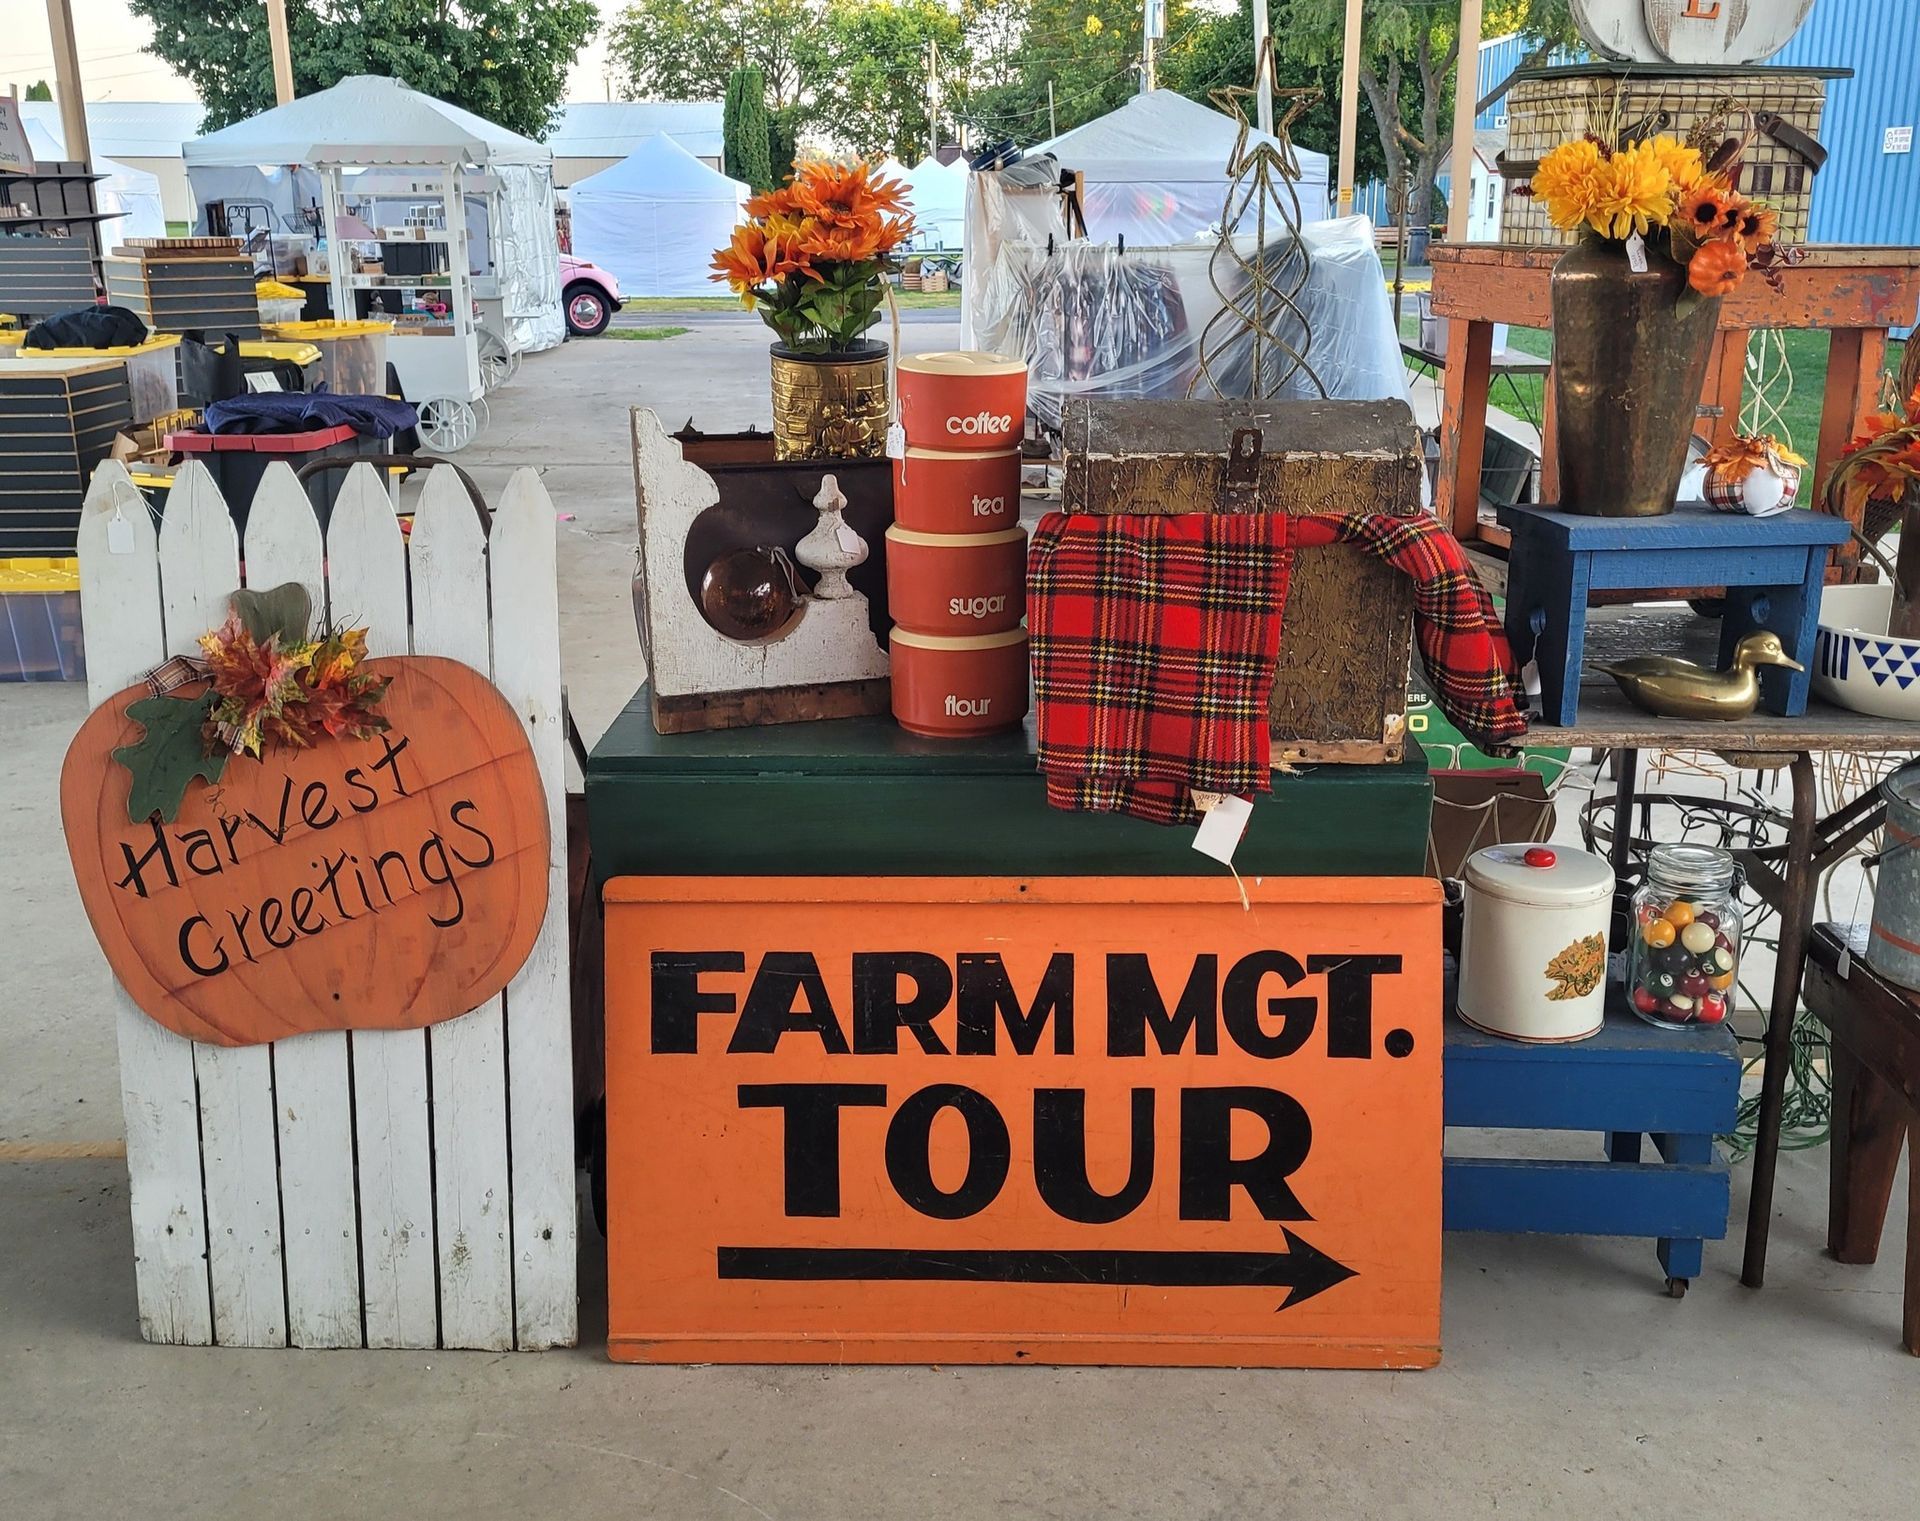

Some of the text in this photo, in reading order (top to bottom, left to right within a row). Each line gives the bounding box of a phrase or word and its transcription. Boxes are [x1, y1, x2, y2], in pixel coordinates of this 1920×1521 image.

[946, 411, 1012, 435] coffee
[972, 495, 1005, 517] tea
[949, 594, 1007, 619] sugar
[944, 695, 991, 717] flour
[114, 734, 411, 898] Harvest
[178, 799, 495, 977] Greetings
[650, 949, 1415, 1059] FARM MGT.
[738, 1083, 1318, 1224] TOUR
